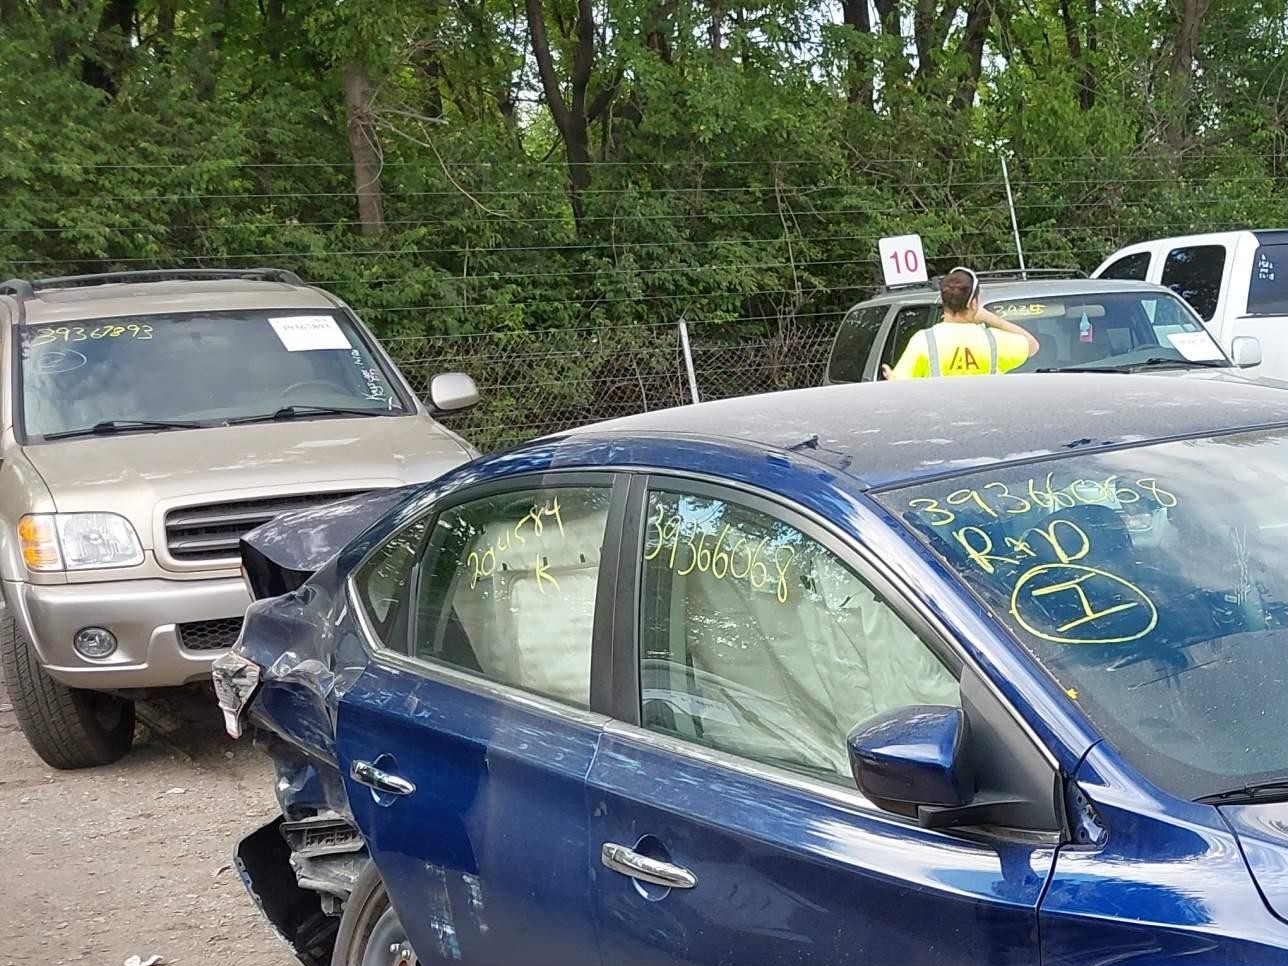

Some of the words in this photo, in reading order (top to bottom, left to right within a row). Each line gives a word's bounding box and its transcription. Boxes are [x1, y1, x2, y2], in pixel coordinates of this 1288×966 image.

[890, 250, 918, 274] 10
[908, 473, 1178, 526] 39366068
[536, 553, 561, 594] K
[644, 503, 795, 603] 39366068
